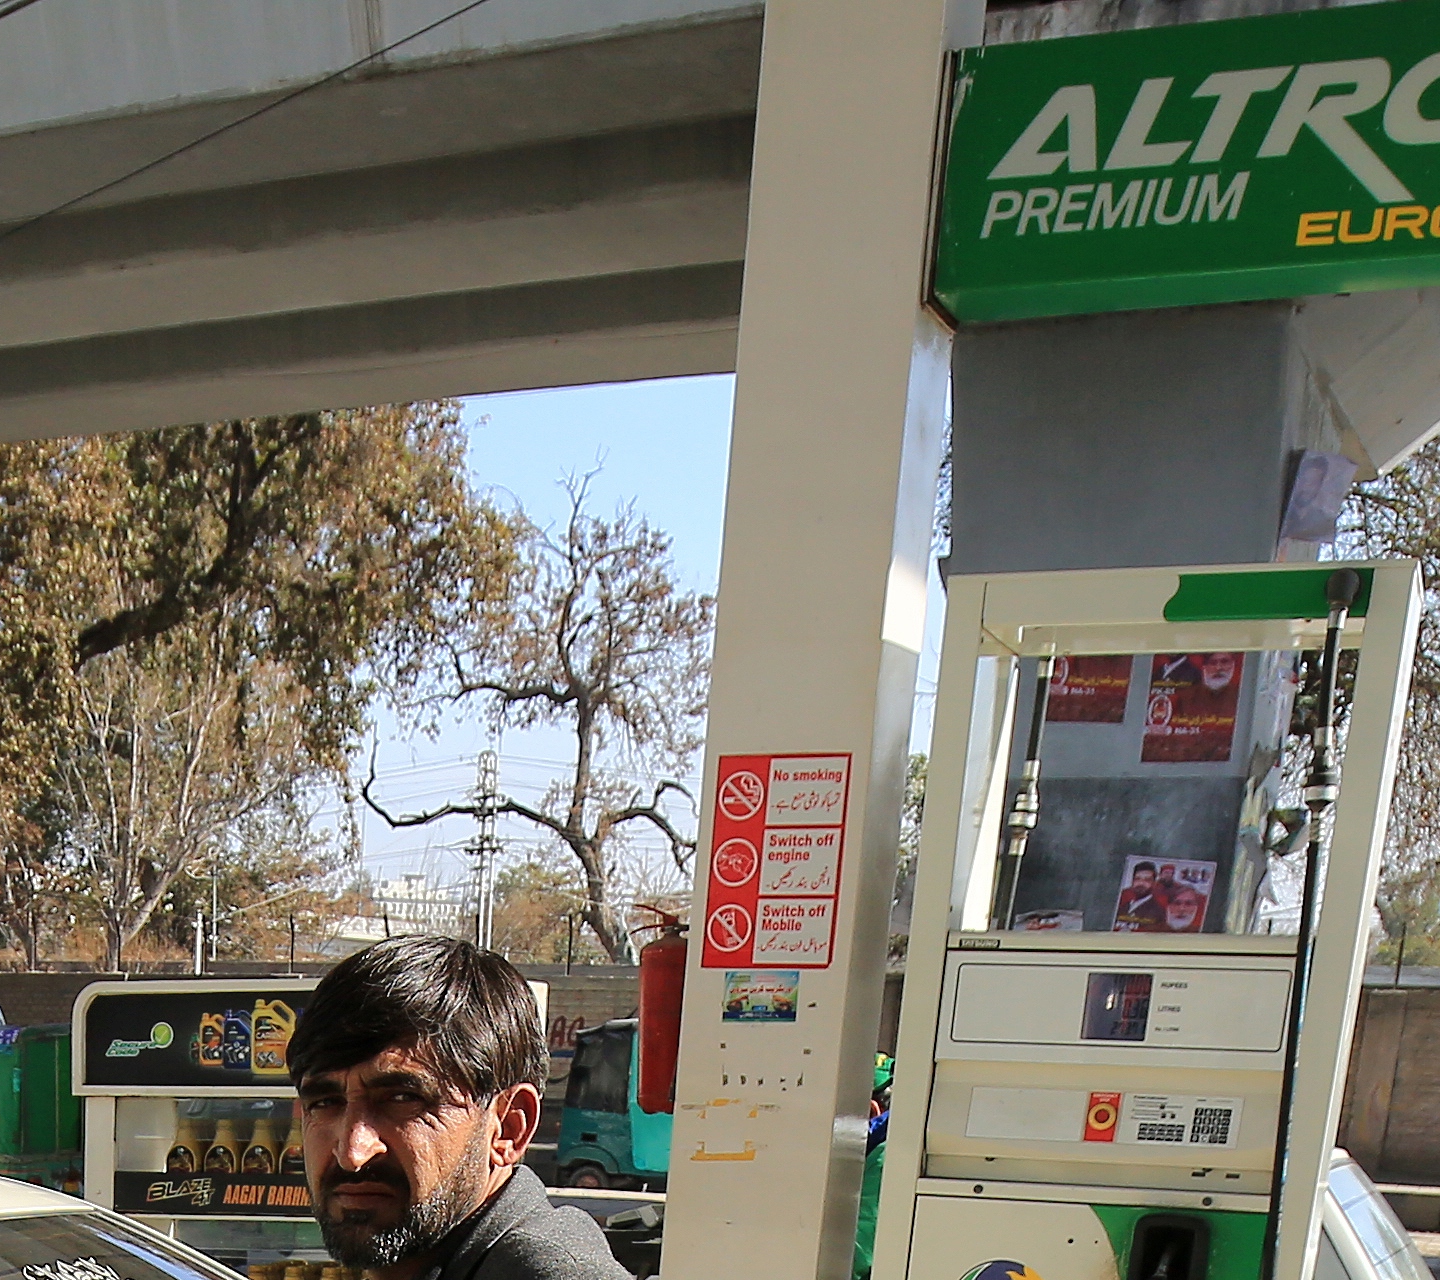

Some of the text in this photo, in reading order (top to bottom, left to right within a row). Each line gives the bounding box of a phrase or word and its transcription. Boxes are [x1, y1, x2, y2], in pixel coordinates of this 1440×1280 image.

[979, 171, 1249, 239] PREMIUM
[773, 769, 842, 784] No smoking
[769, 833, 835, 847] Switch off
[768, 850, 810, 864] engine
[762, 904, 826, 917] Switch off
[762, 919, 802, 931] Mobile
[112, 1039, 157, 1050] Secure
[108, 1049, 138, 1057] Code
[146, 1178, 212, 1201] BLAZE
[222, 1184, 311, 1206] AAGAY BARHN
